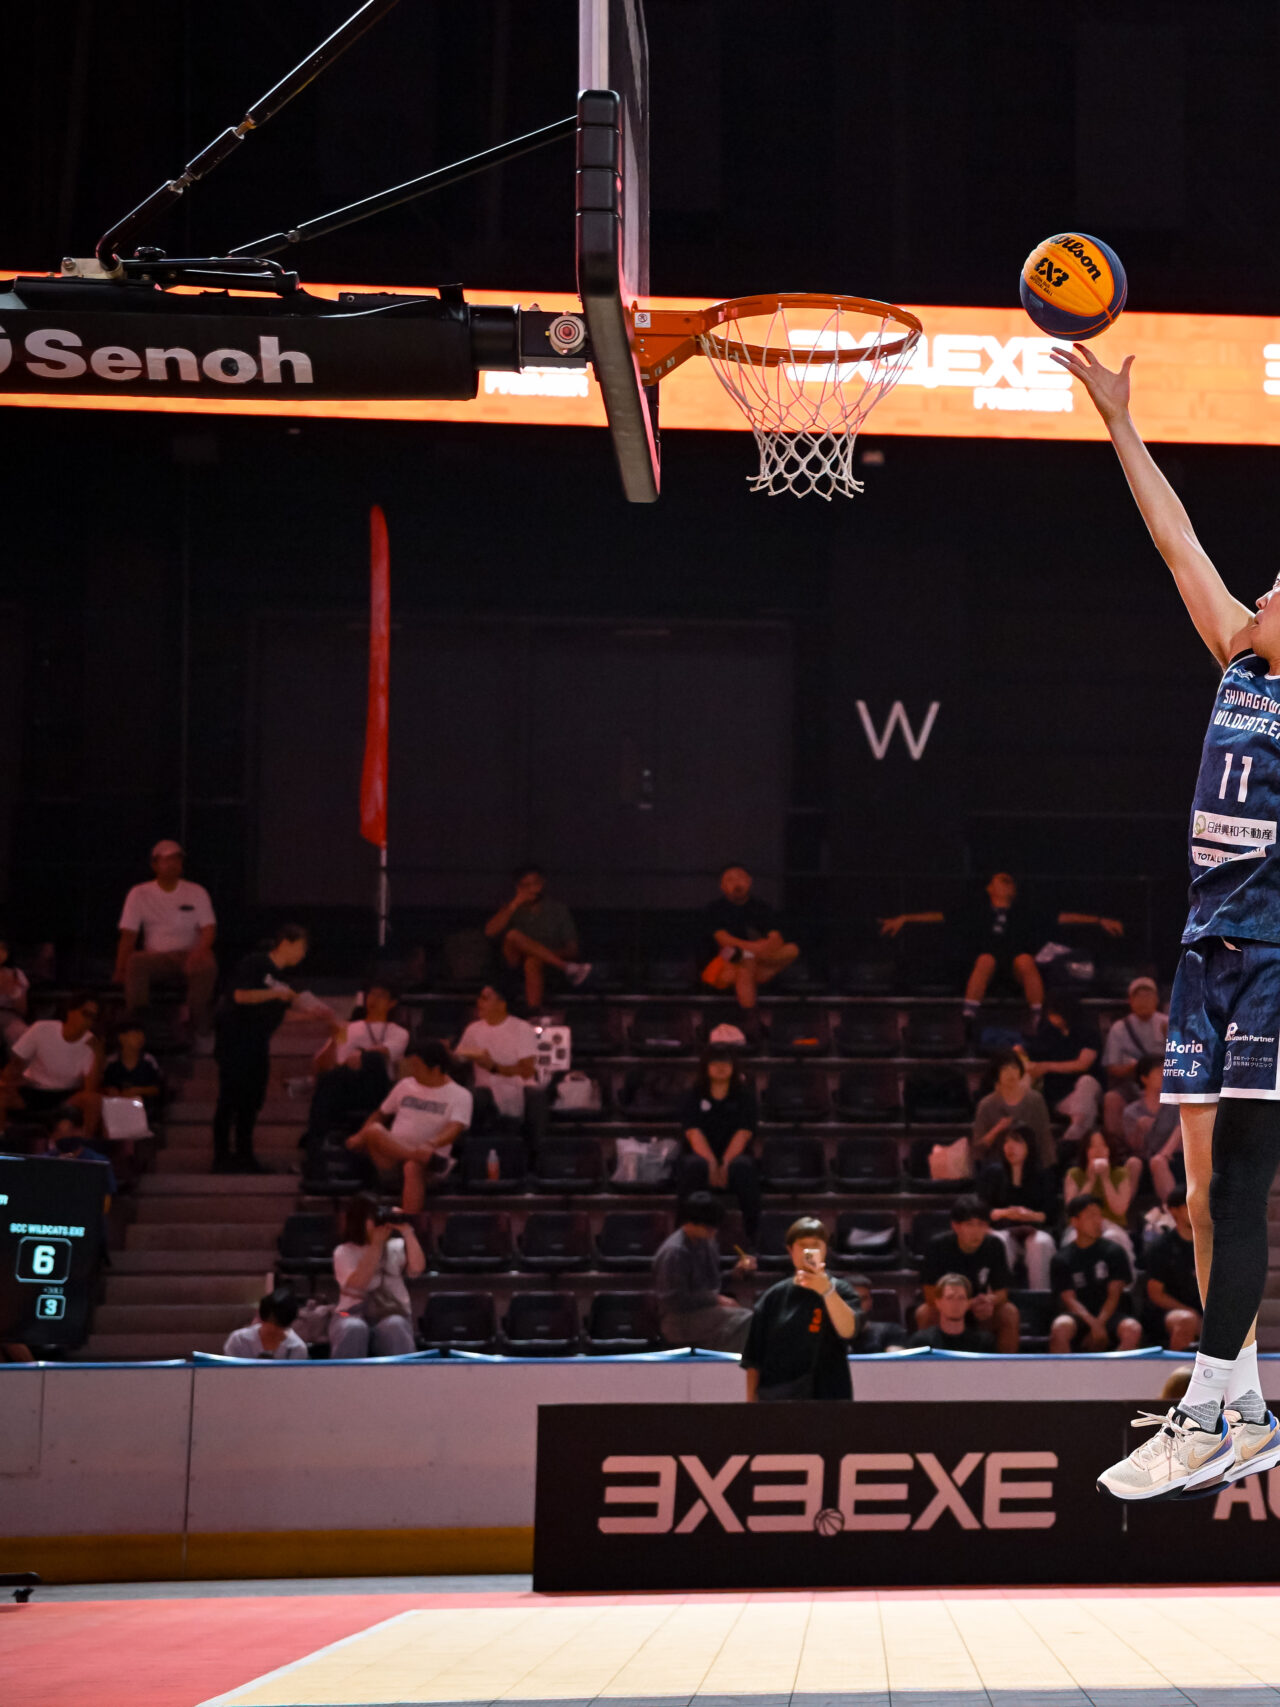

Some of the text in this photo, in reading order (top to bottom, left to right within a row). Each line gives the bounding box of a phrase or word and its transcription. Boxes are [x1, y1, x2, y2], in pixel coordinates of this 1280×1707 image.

[24, 328, 313, 384] Senoh
[855, 700, 941, 760] W
[1218, 753, 1253, 803] 11
[1165, 1039, 1203, 1054] ictoria
[1249, 1034, 1275, 1043] Partner
[32, 1245, 56, 1275] 6
[44, 1298, 58, 1316] 3
